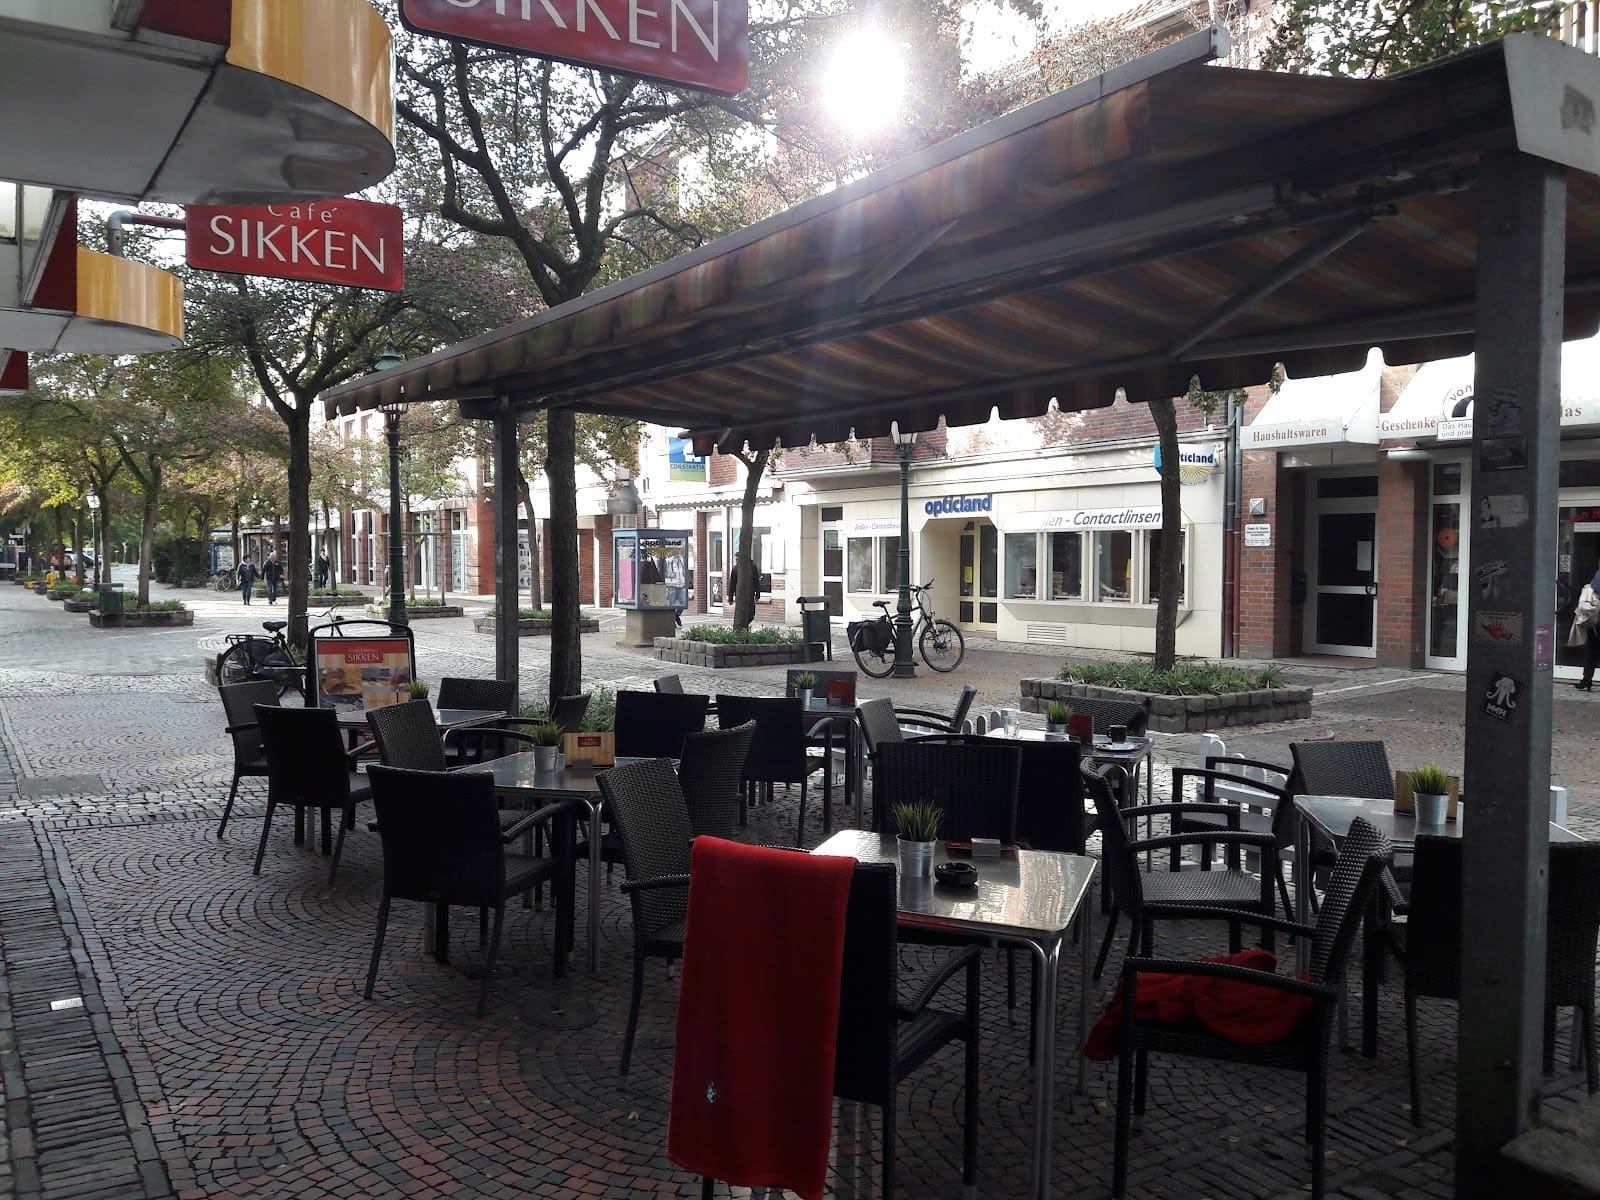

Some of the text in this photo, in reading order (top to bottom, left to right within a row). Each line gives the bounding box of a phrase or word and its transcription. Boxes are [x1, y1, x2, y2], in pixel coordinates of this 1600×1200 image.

[443, 0, 719, 62] KEN
[210, 214, 385, 274] SIKKEN
[1559, 405, 1582, 418] las
[1381, 416, 1436, 432] Geschenke
[1457, 421, 1473, 429] Hau
[1253, 427, 1327, 442] Haushaltswaren
[1456, 428, 1473, 437] prak
[1180, 452, 1214, 464] ticland
[924, 492, 993, 517] opticland
[1073, 510, 1161, 526] Contactlinsen
[347, 652, 380, 662] SIKKEN
